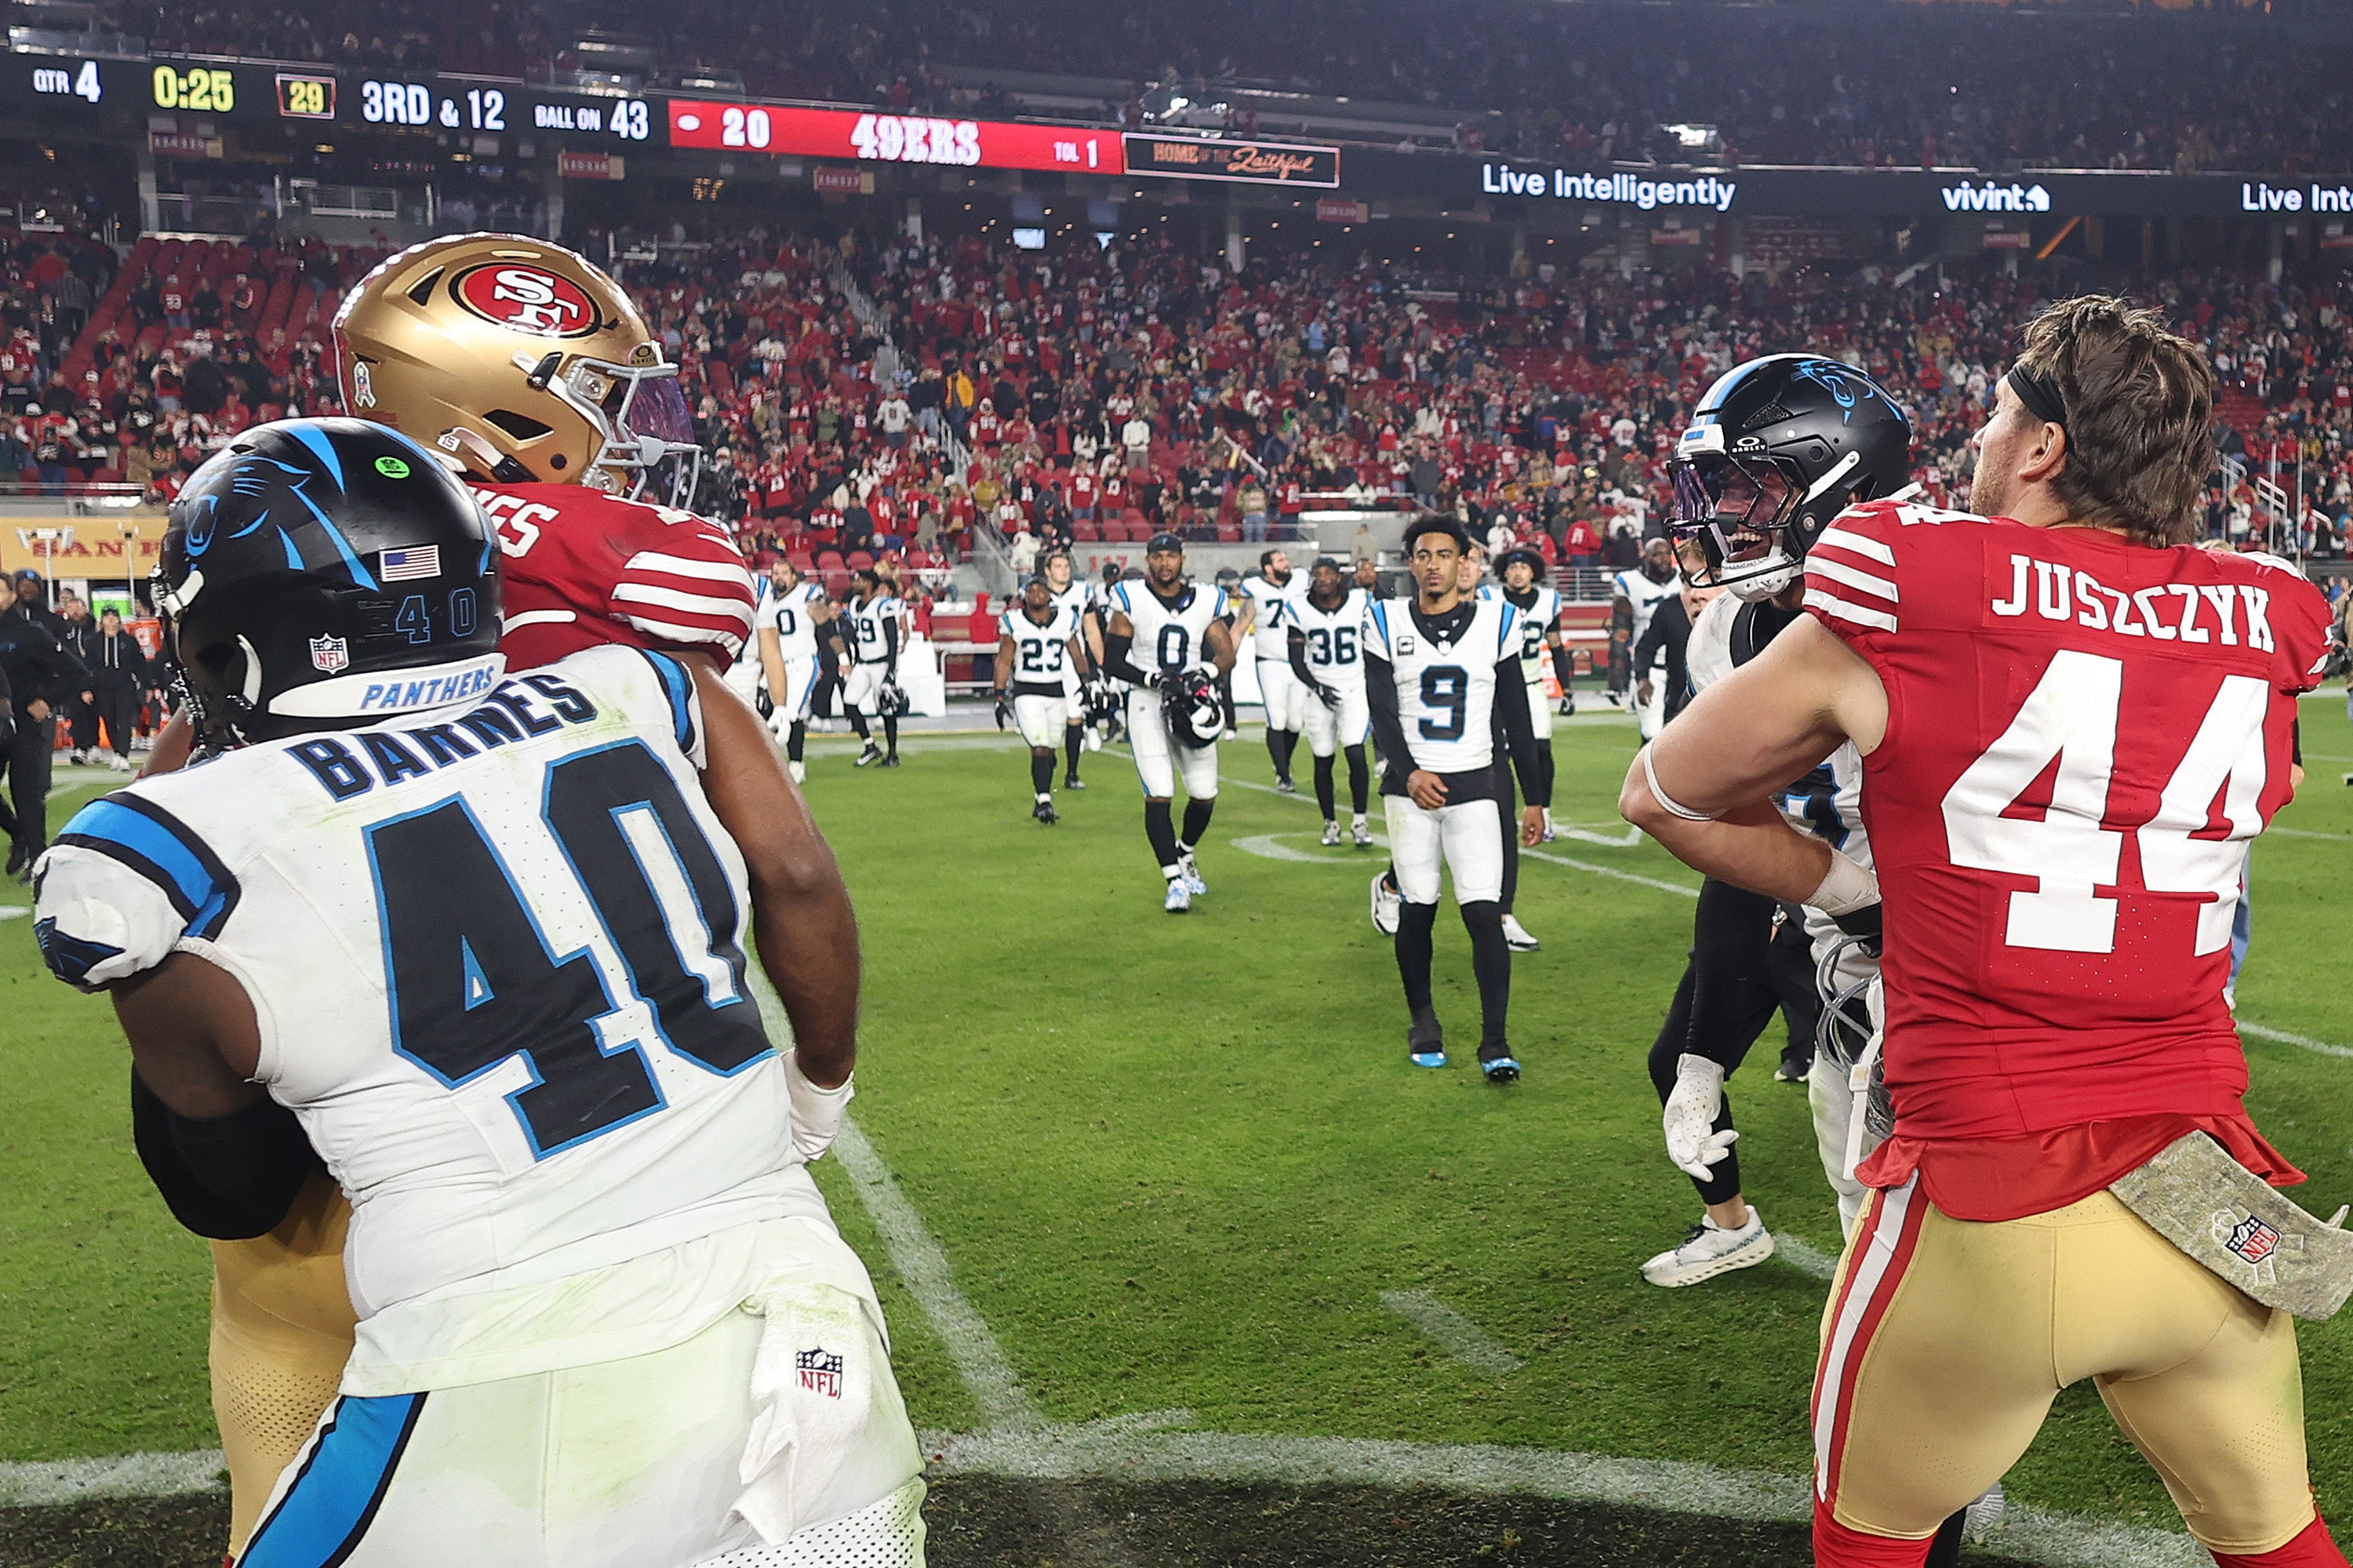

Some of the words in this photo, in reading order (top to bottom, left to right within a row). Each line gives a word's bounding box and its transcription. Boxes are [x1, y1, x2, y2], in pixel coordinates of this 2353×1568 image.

[34, 68, 70, 93] QTR
[75, 60, 101, 103] 4
[153, 65, 235, 112] 0:25
[289, 80, 324, 113] 29
[362, 80, 431, 125] 3RD
[438, 98, 460, 127] &
[466, 88, 506, 130] 12
[533, 105, 575, 129] BALL
[576, 107, 602, 131] ON
[609, 100, 649, 140] 43
[722, 107, 770, 148] 20
[850, 114, 981, 166] 49ERS
[1086, 138, 1097, 168] 1
[1153, 142, 1200, 164] HOME
[1226, 146, 1315, 180] Faithful
[1482, 163, 1546, 195] Live
[1555, 169, 1736, 212] Intelligently
[2242, 182, 2303, 211] Live
[2311, 183, 2353, 212] Int
[493, 270, 579, 328] SF
[442, 436, 455, 448] 15
[32, 539, 123, 557] SAN
[395, 588, 478, 644] 40
[1991, 555, 2275, 654] JUSZCZYK
[317, 652, 346, 667] NFL
[1021, 638, 1065, 673] 23
[1157, 622, 1190, 672] 0
[1307, 625, 1358, 666] 36
[360, 664, 495, 710] PANTHERS
[1418, 664, 1469, 743] 9
[282, 674, 598, 802] BARNES
[1940, 649, 2270, 957] 44
[362, 737, 777, 1162] 40
[2241, 1229, 2278, 1261] NFL
[799, 1370, 838, 1398] NFL
